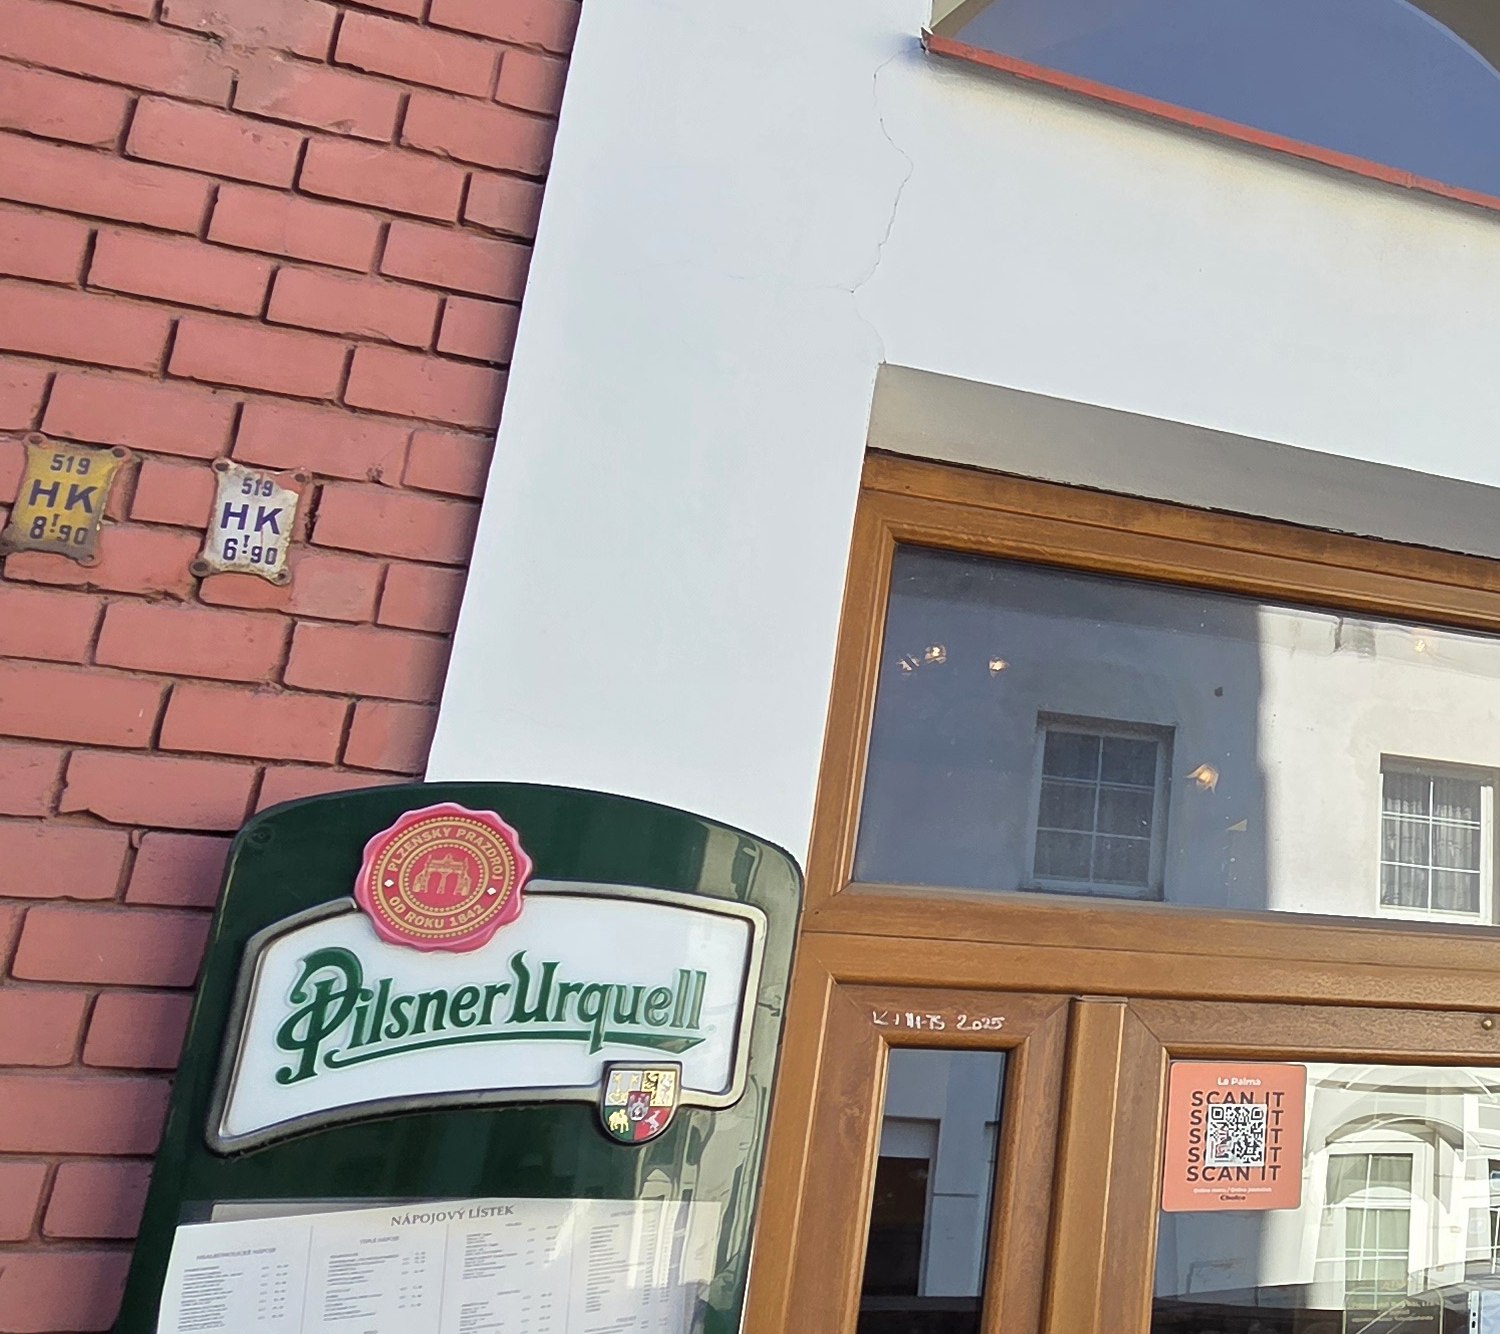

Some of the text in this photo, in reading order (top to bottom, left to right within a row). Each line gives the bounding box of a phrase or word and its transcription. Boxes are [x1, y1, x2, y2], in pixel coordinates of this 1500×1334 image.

[50, 454, 91, 475] 519
[28, 479, 99, 514] HK
[241, 476, 274, 497] 519
[220, 502, 283, 535] HK
[456, 828, 503, 881] PRAZDROJ
[389, 896, 485, 928] OD ROKU 1842
[275, 946, 707, 1085] Pilsner Urquell
[957, 1014, 1005, 1031] 2025
[1231, 1077, 1261, 1086] Palma
[1191, 1091, 1285, 1108] SCAN IT
[1186, 1165, 1281, 1182] SCAN IT
[391, 1205, 514, 1227] NÁPOJOVÝ LÍSTEK
